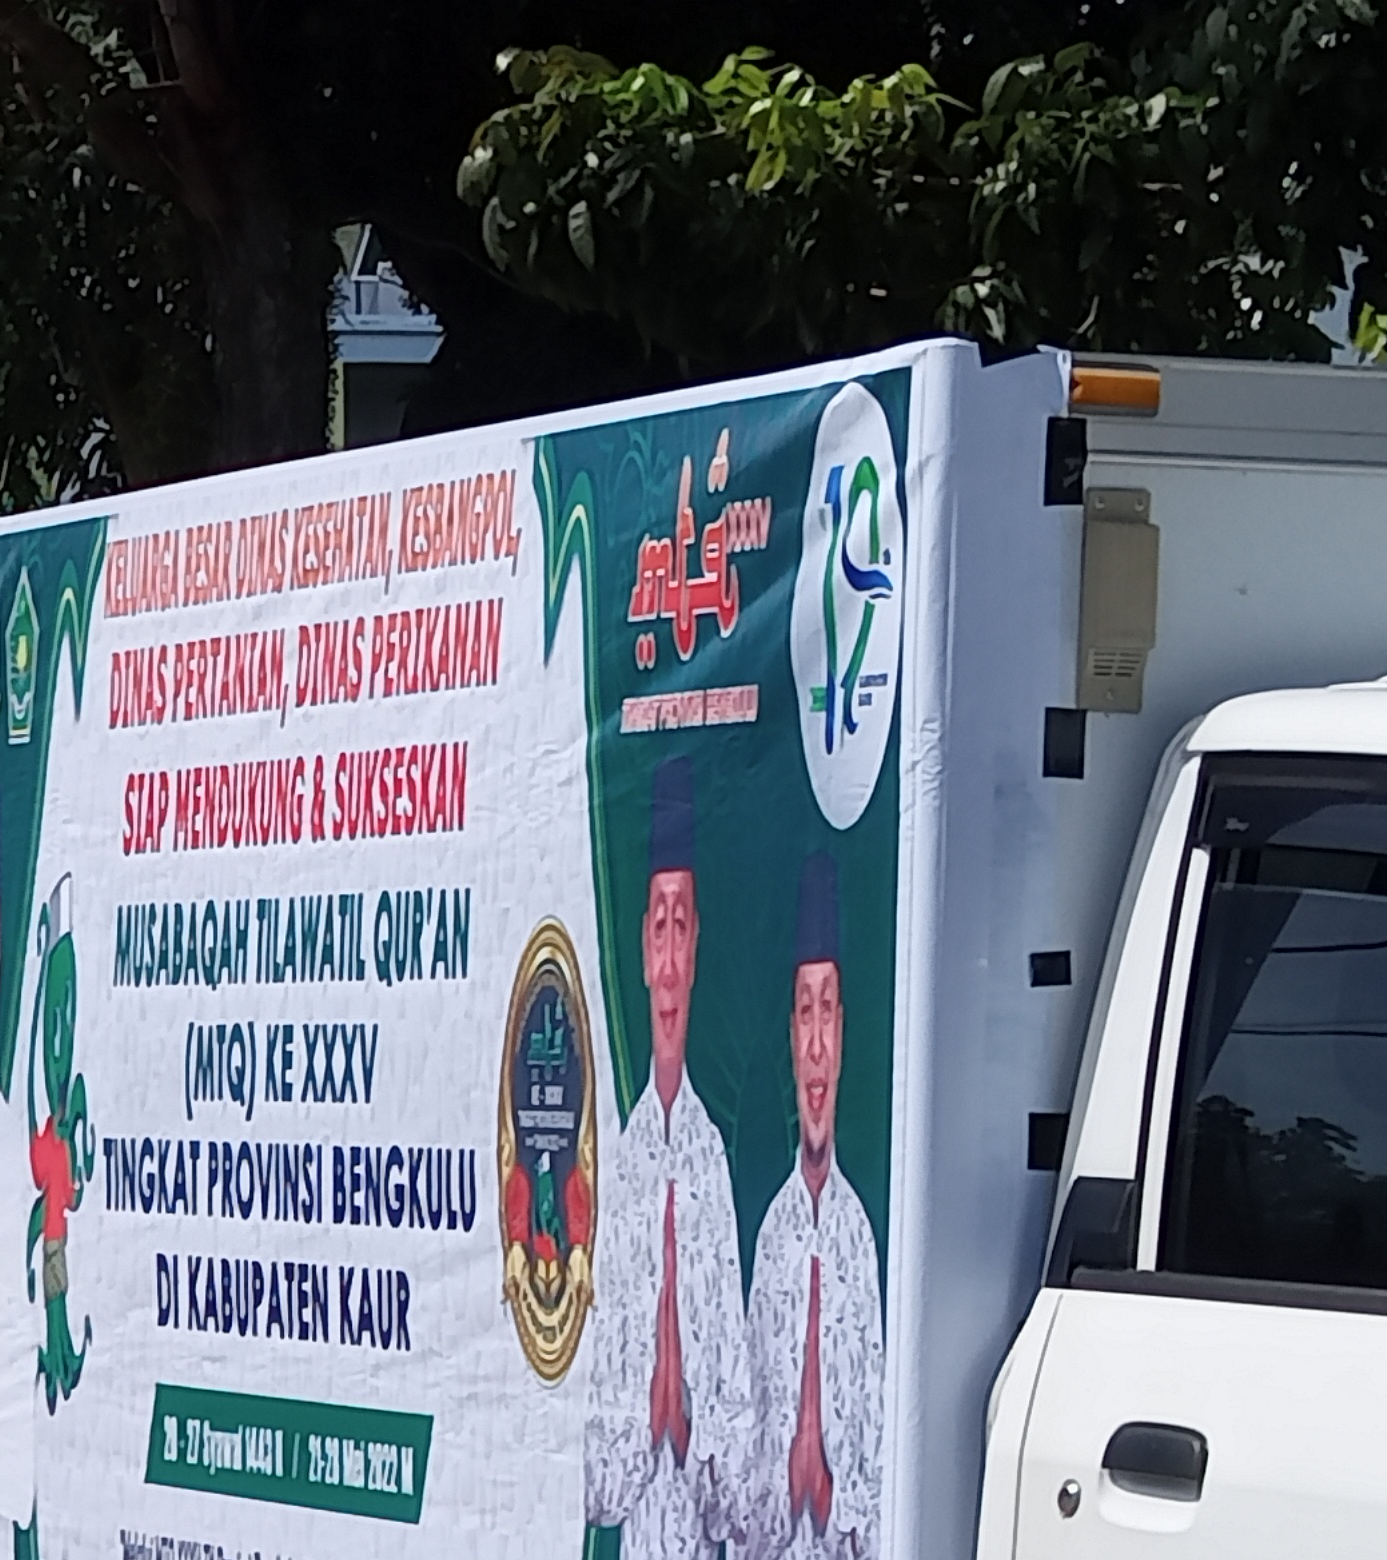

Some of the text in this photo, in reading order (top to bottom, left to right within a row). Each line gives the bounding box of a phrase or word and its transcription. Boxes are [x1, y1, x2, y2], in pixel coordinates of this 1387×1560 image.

[104, 469, 521, 618] KELUARGA BESAR DINAS KESEHATAN, KESBANGPOL,
[109, 597, 503, 729] DINAS PERTANIAN, DINAS PERIKANAN
[123, 741, 468, 856] SIAP MENDUKUNG & SUKSESKAN
[113, 887, 471, 989] MUSABAQAH TILAWATIL QUR'AN
[185, 1021, 379, 1121] (MTQ) KE XXXV
[103, 1137, 475, 1232] TINGKAT PROVINSI BENGKULU
[156, 1253, 411, 1352] DI KABUPATEN KAUR
